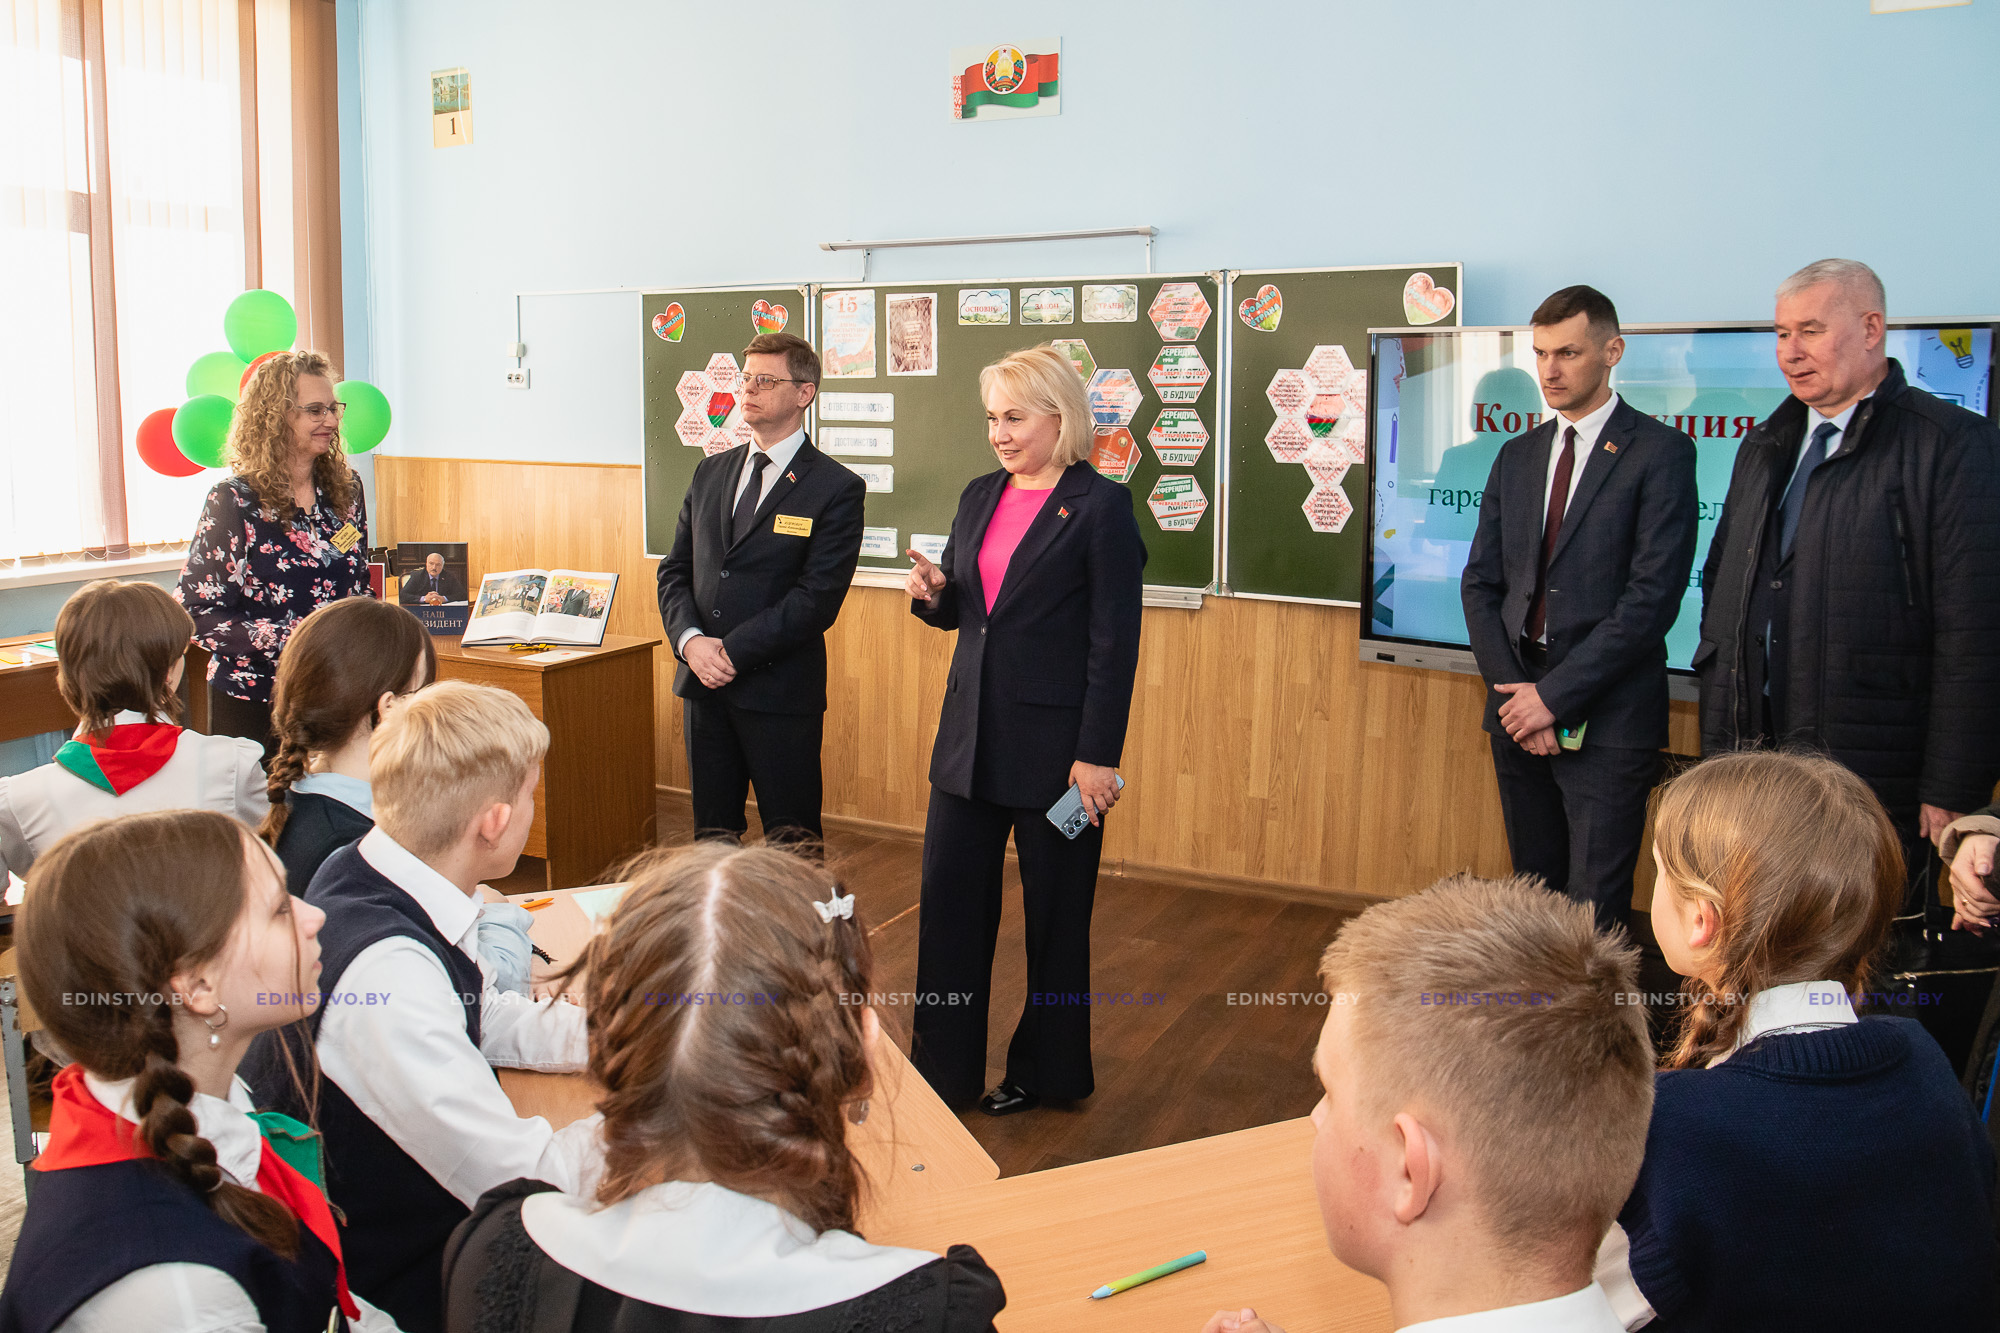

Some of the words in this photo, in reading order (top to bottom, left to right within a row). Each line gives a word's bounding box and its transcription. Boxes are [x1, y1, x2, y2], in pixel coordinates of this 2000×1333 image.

[450, 117, 456, 135] 1
[837, 296, 858, 313] 15
[1244, 290, 1277, 316] РОДНАЯ
[1407, 287, 1442, 317] РОДИНА
[1250, 302, 1281, 327] СТРАНА
[1163, 391, 1168, 399] В
[828, 402, 884, 413] ОТВЕТСТВЕННОСТЬ
[834, 437, 878, 448] ДОСТОИНСТВО
[1162, 453, 1168, 461] В
[422, 610, 445, 618] НАШ
[423, 620, 463, 629] ЗИДЕНТ
